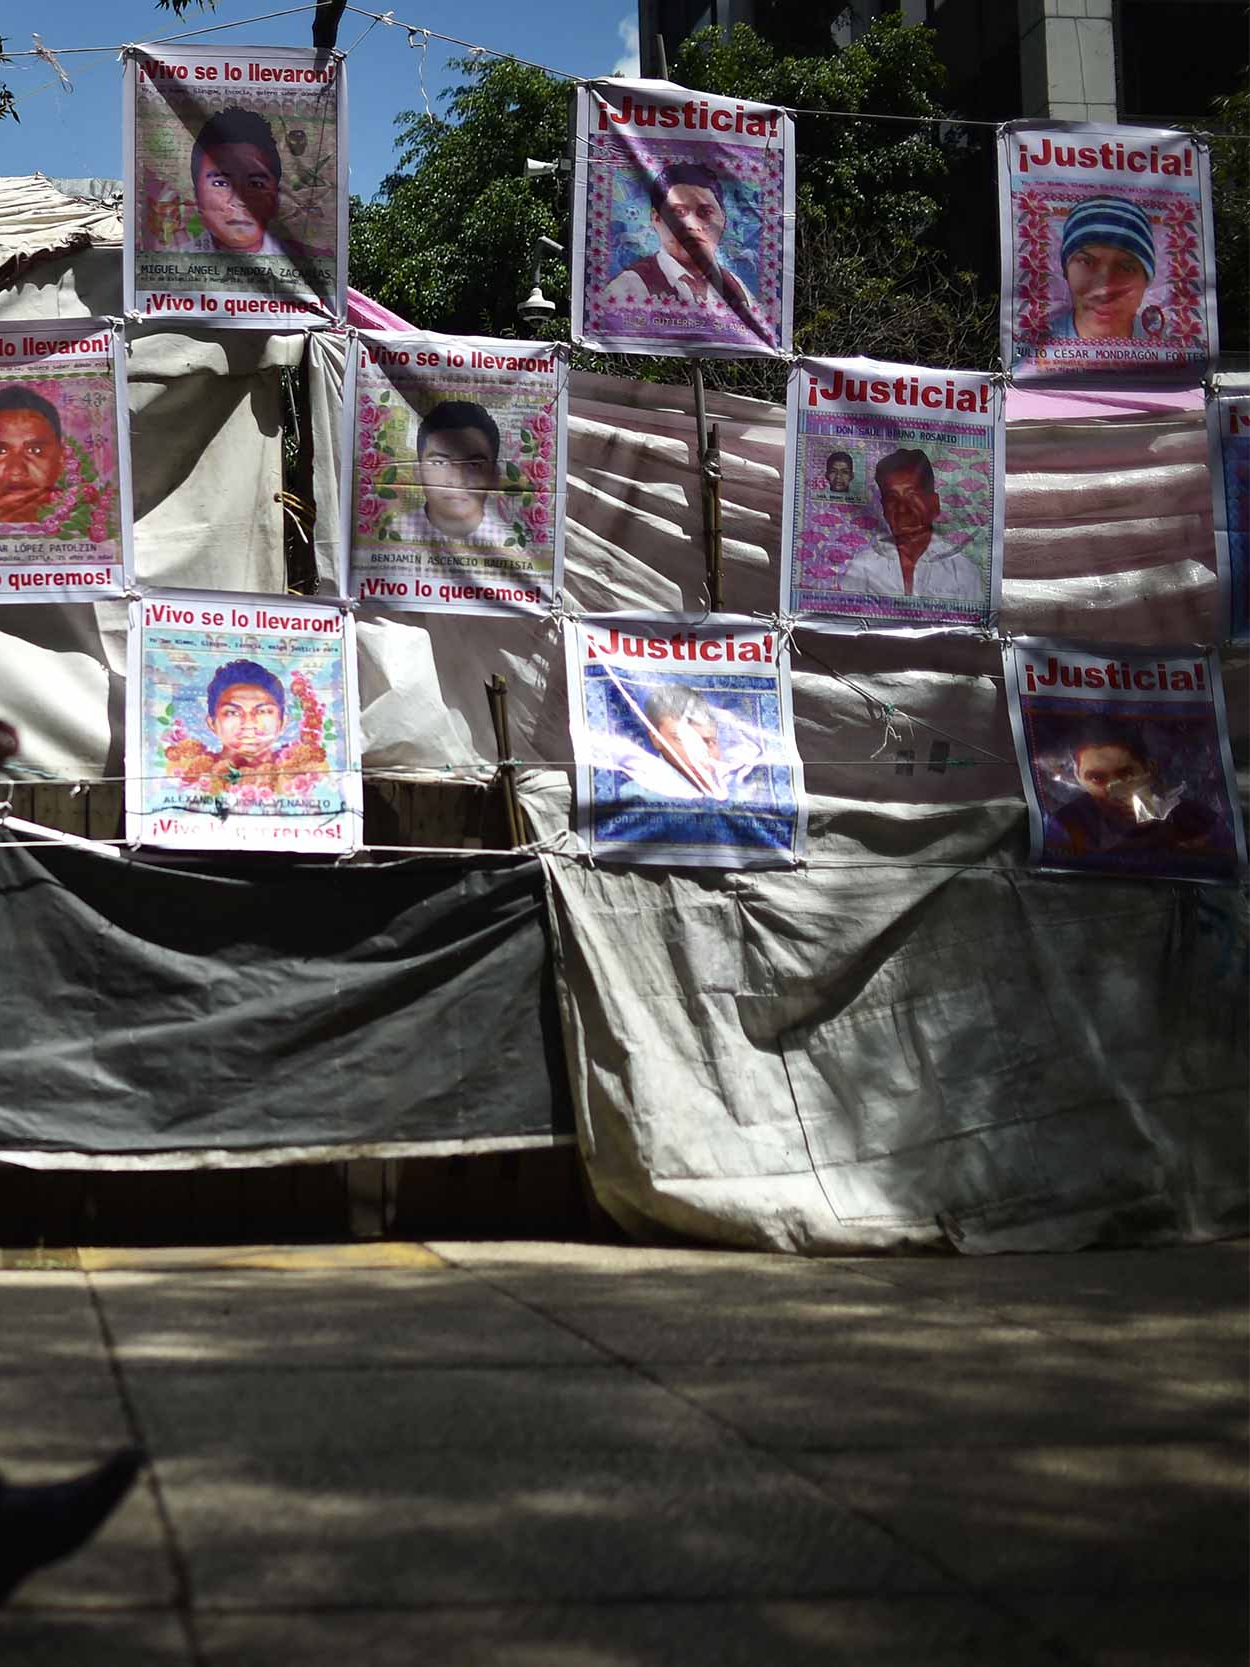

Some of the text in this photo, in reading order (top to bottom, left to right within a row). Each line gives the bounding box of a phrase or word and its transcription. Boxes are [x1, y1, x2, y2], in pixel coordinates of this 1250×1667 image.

[139, 59, 335, 84] ¡Vivo se lo llevaron!
[596, 95, 779, 138] ¡Justicia!
[1018, 138, 1193, 177] ¡Justicia!
[140, 264, 179, 275] MIGUEL
[146, 293, 326, 316] ¡Vivo lo queremos!
[22, 334, 110, 356] llevaron!
[360, 345, 555, 373] ¡Vivo se lo llevaron!
[807, 369, 990, 414] ¡Justicia!
[836, 425, 853, 435] DON
[919, 431, 957, 444] ROSARIO
[14, 543, 44, 553] LÓPEZ
[49, 542, 97, 553] PATOLZIN
[8, 567, 111, 590] queremos!
[359, 577, 542, 604] ¡Vivo lo queremos!
[145, 603, 341, 633] ¡Vivo se lo llevaron!
[587, 628, 774, 664] ¡Justicia!
[1024, 656, 1206, 692] ¡Justicia!
